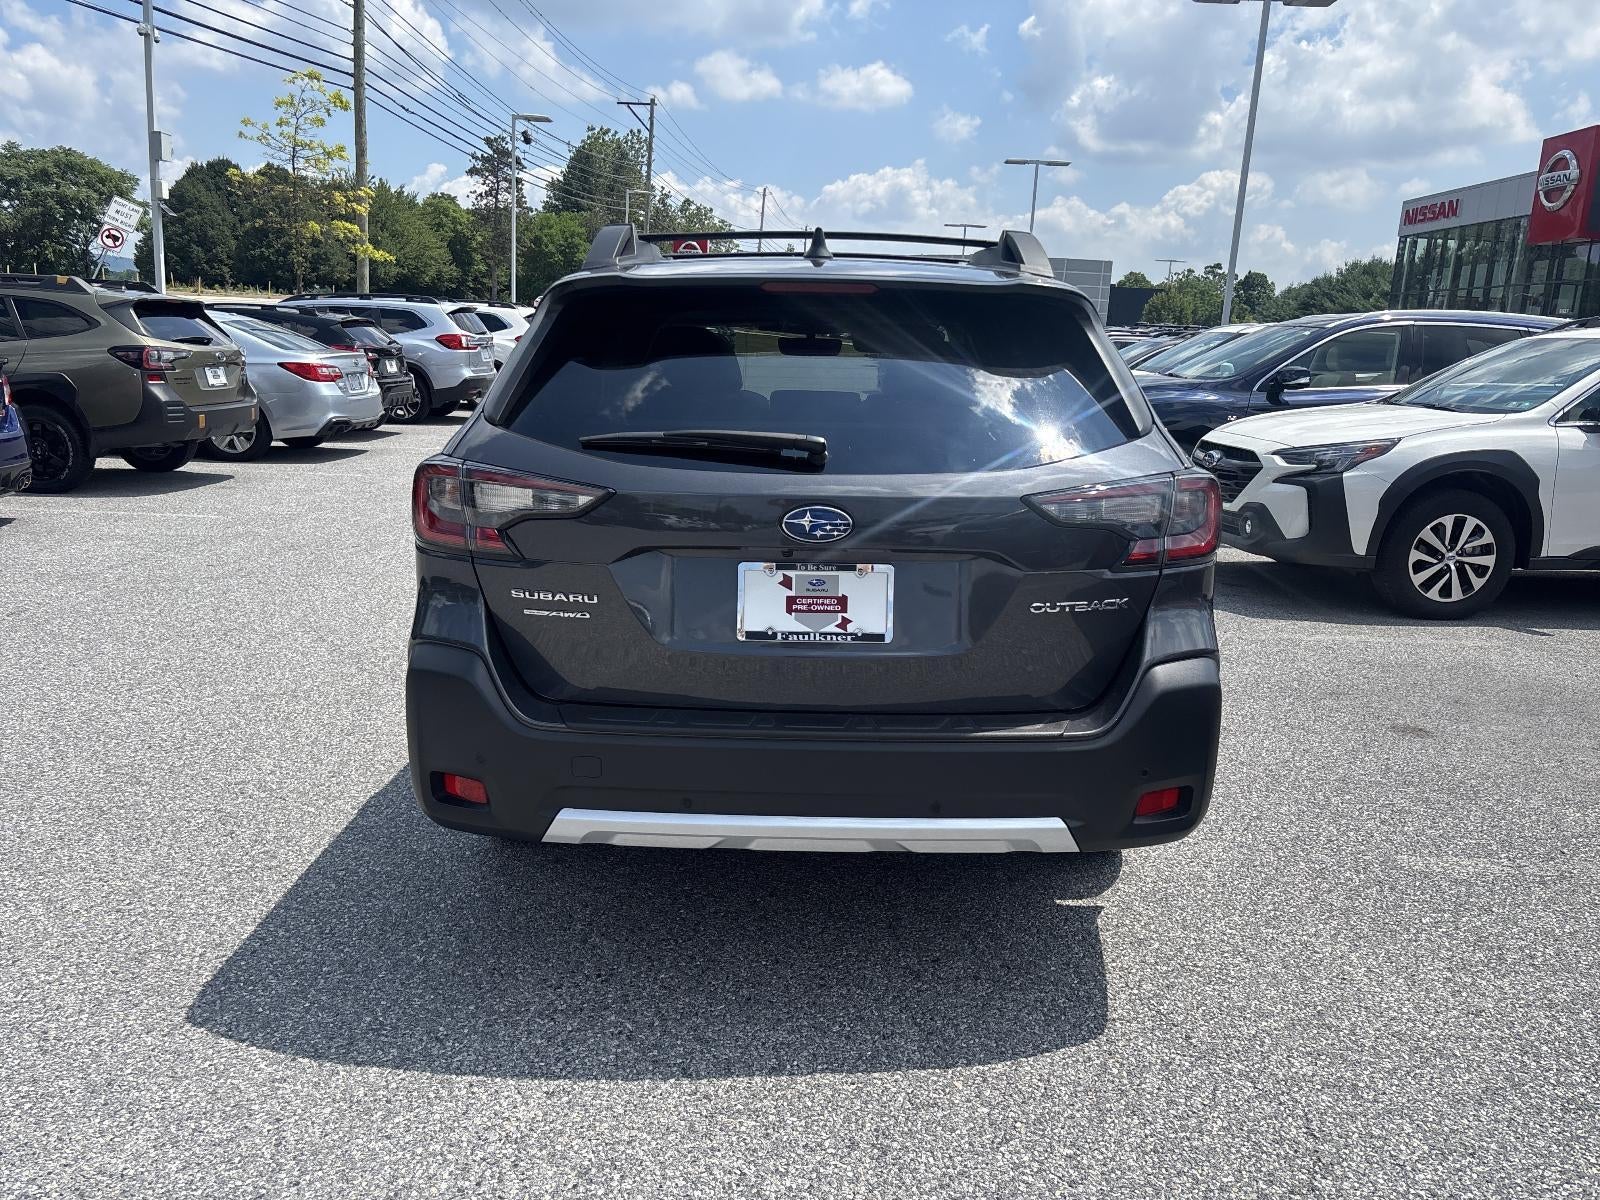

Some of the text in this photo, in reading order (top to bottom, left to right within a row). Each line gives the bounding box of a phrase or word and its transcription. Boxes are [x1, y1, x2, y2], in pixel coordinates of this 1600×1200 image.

[113, 200, 128, 209] RIGHT
[115, 208, 133, 220] MUST
[1403, 198, 1459, 226] NISSAN
[509, 588, 598, 604] SUBARU
[1029, 597, 1129, 613] OUTBACK
[548, 610, 591, 619] AWD
[776, 632, 856, 642] Faulkner
